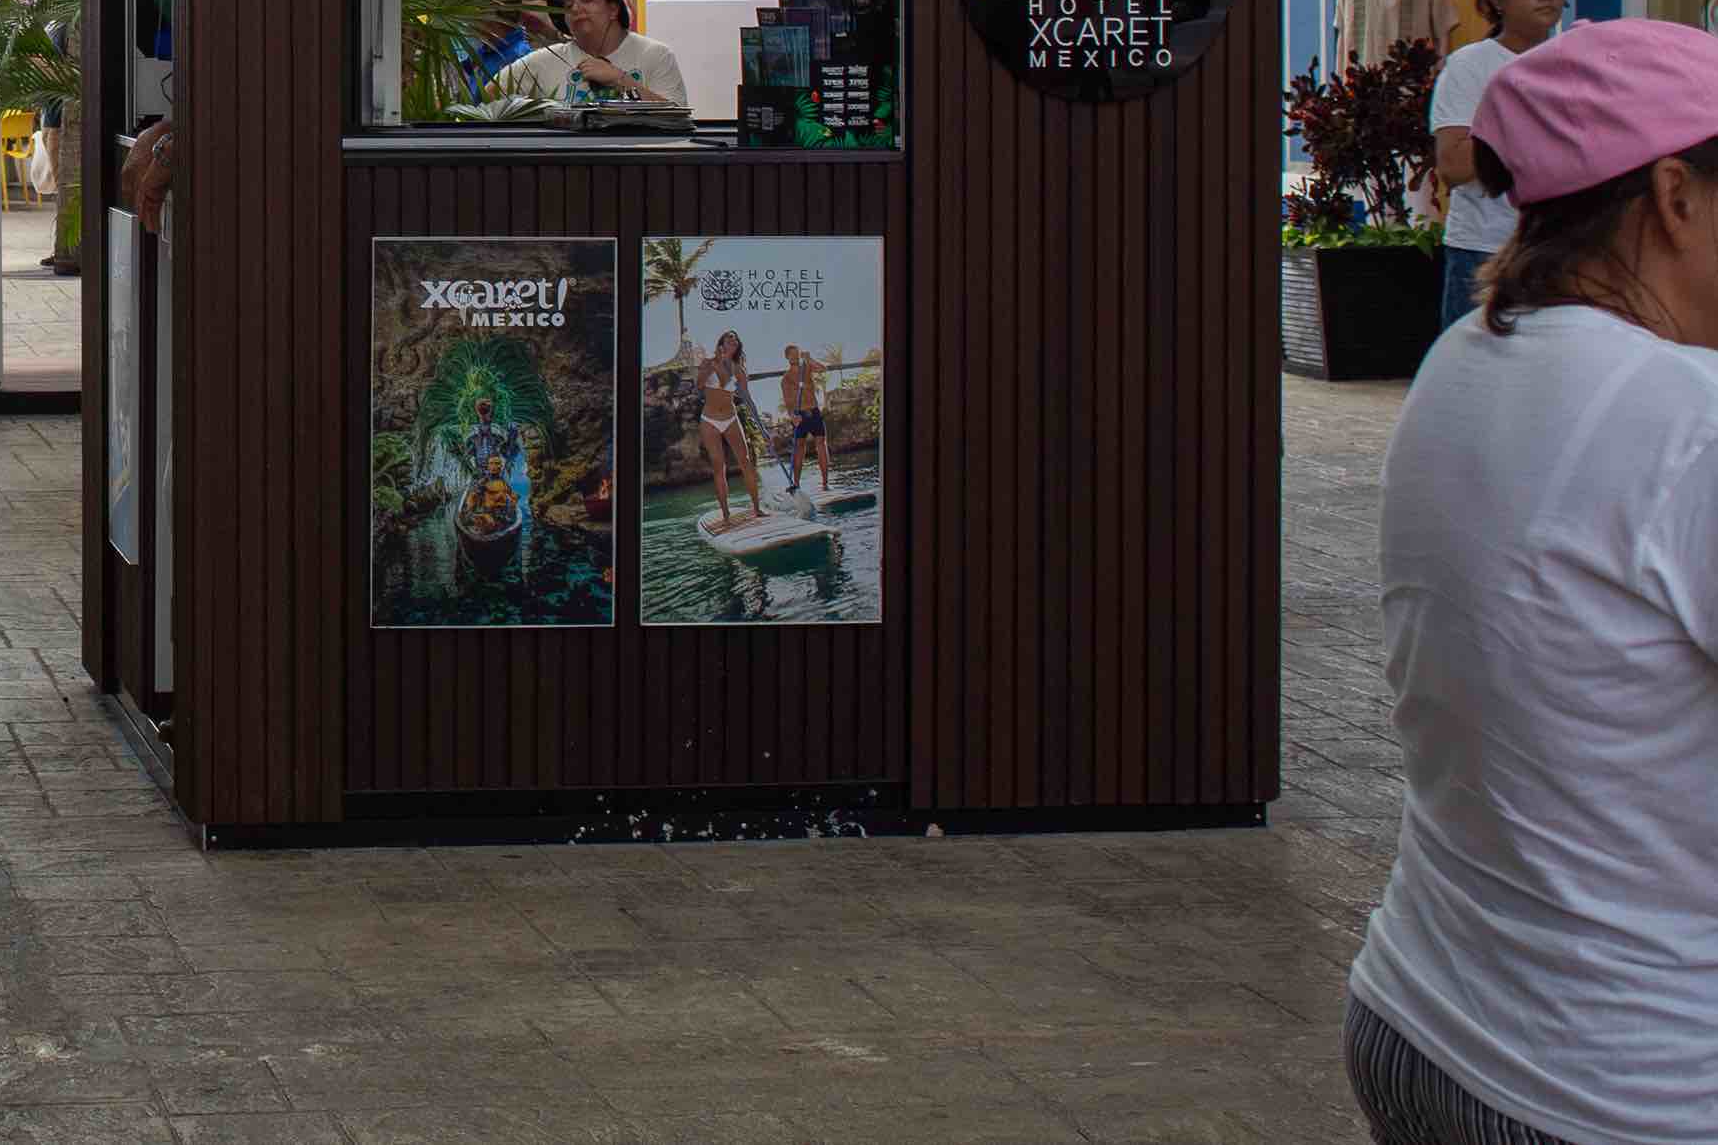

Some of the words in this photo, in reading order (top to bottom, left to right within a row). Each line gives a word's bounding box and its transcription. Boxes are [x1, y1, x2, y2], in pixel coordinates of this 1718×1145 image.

[1028, 17, 1172, 46] XCARET
[748, 270, 825, 279] HOTEL
[748, 281, 825, 298] XCARET
[471, 312, 566, 327] MEXICO
